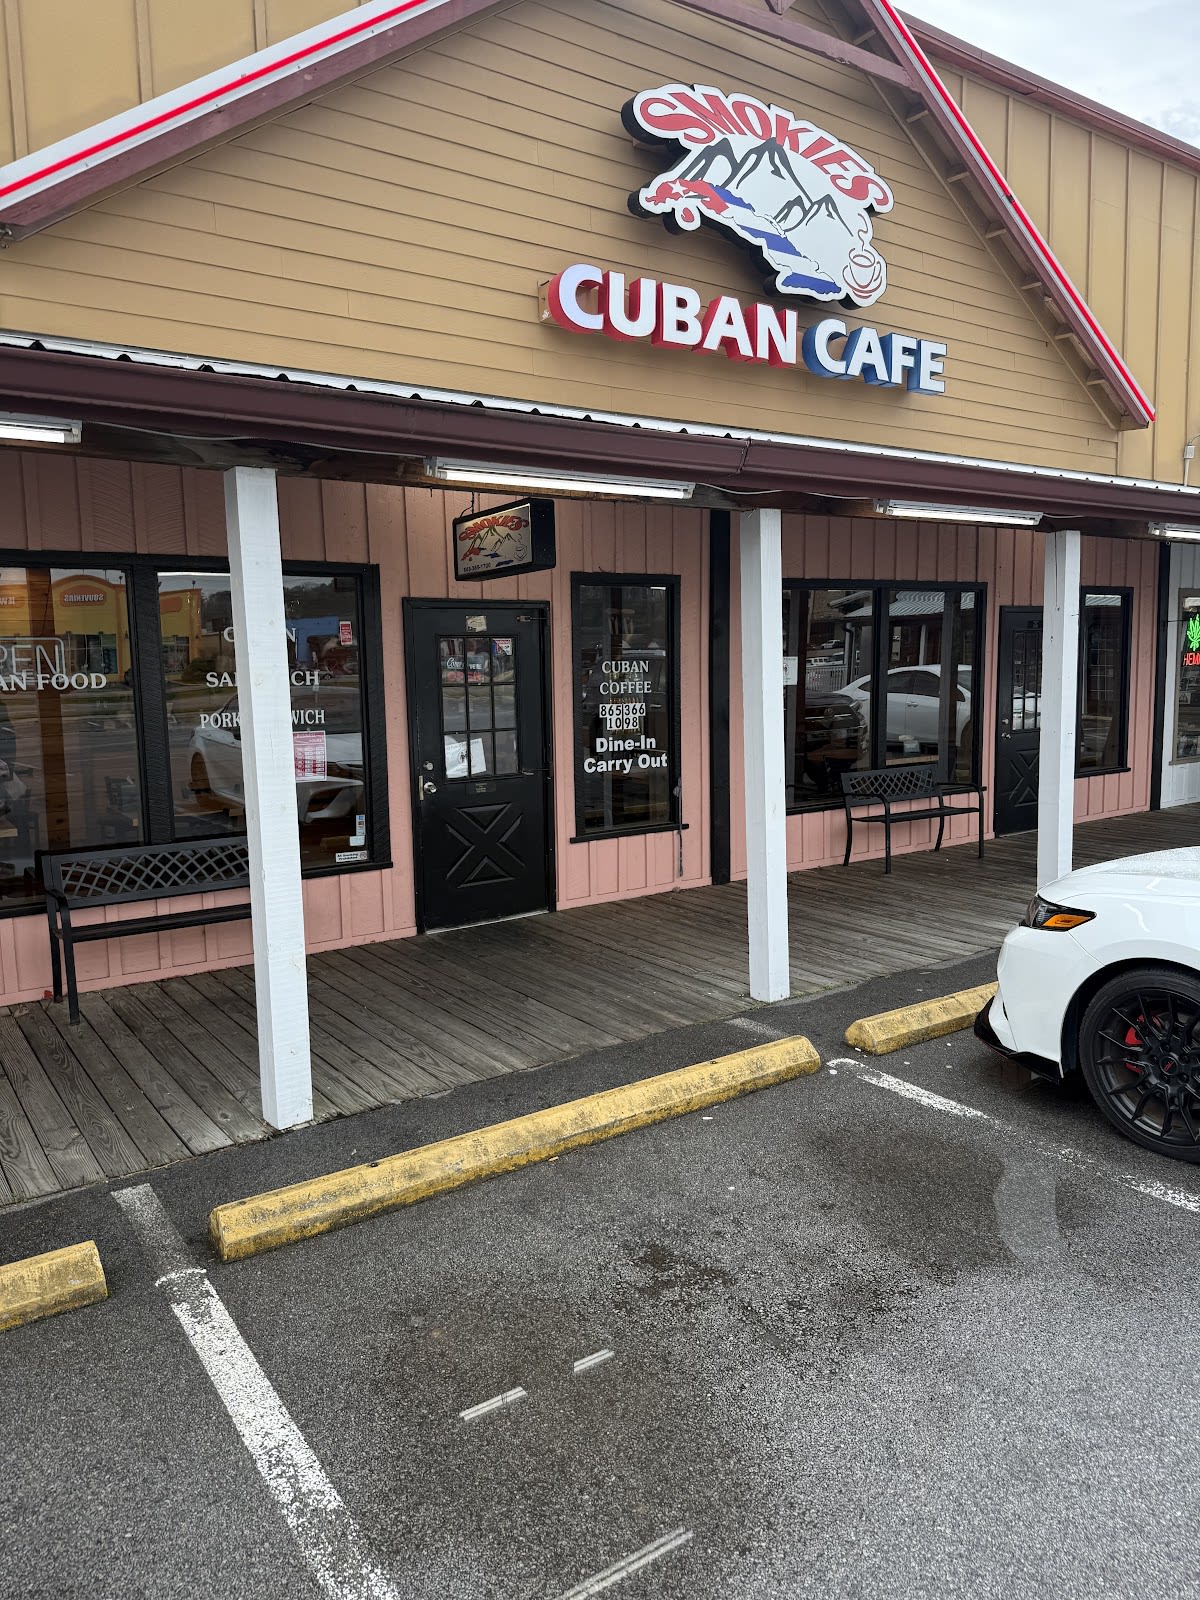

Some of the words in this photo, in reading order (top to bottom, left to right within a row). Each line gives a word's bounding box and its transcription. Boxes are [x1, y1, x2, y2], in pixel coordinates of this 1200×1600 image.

[639, 91, 890, 208] SMOKIES
[556, 263, 799, 365] CUBAN
[811, 318, 948, 395] CAFE
[601, 660, 649, 674] CUBAN
[37, 672, 107, 691] FOOD
[206, 670, 320, 689] SACH
[599, 681, 652, 695] COFFEE
[600, 704, 622, 717] 865
[624, 703, 645, 716] 366
[200, 712, 241, 729] PORK
[608, 717, 638, 729] 1098
[596, 735, 656, 753] Dine-In
[583, 757, 634, 774] Carry
[638, 753, 668, 769] Out
